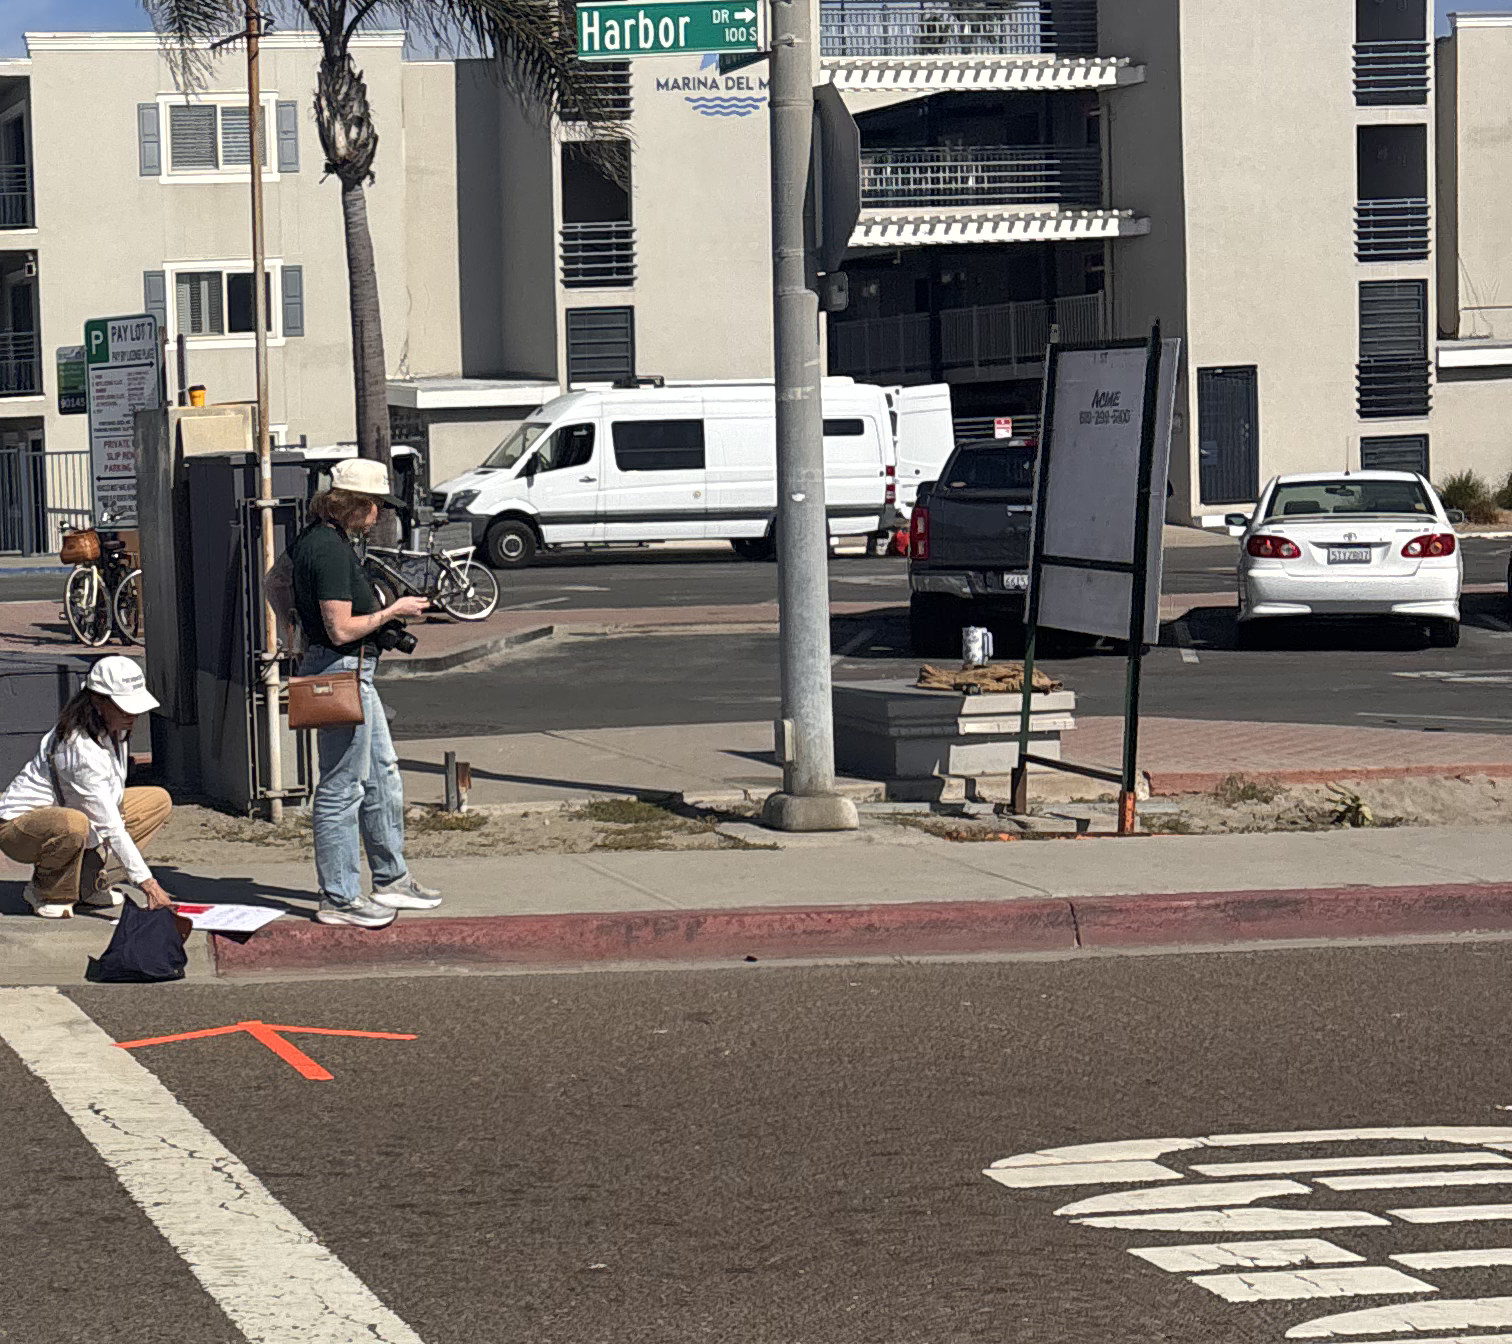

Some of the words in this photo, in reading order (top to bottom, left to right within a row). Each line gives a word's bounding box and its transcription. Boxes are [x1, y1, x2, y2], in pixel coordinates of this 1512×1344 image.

[582, 9, 691, 51] Harbor
[712, 9, 730, 24] DR
[724, 27, 746, 42] 100
[749, 27, 757, 42] S
[656, 76, 720, 91] MARINA
[725, 76, 754, 91] DEL
[91, 330, 104, 355] P
[111, 325, 128, 343] PAY
[130, 323, 146, 341] LOT
